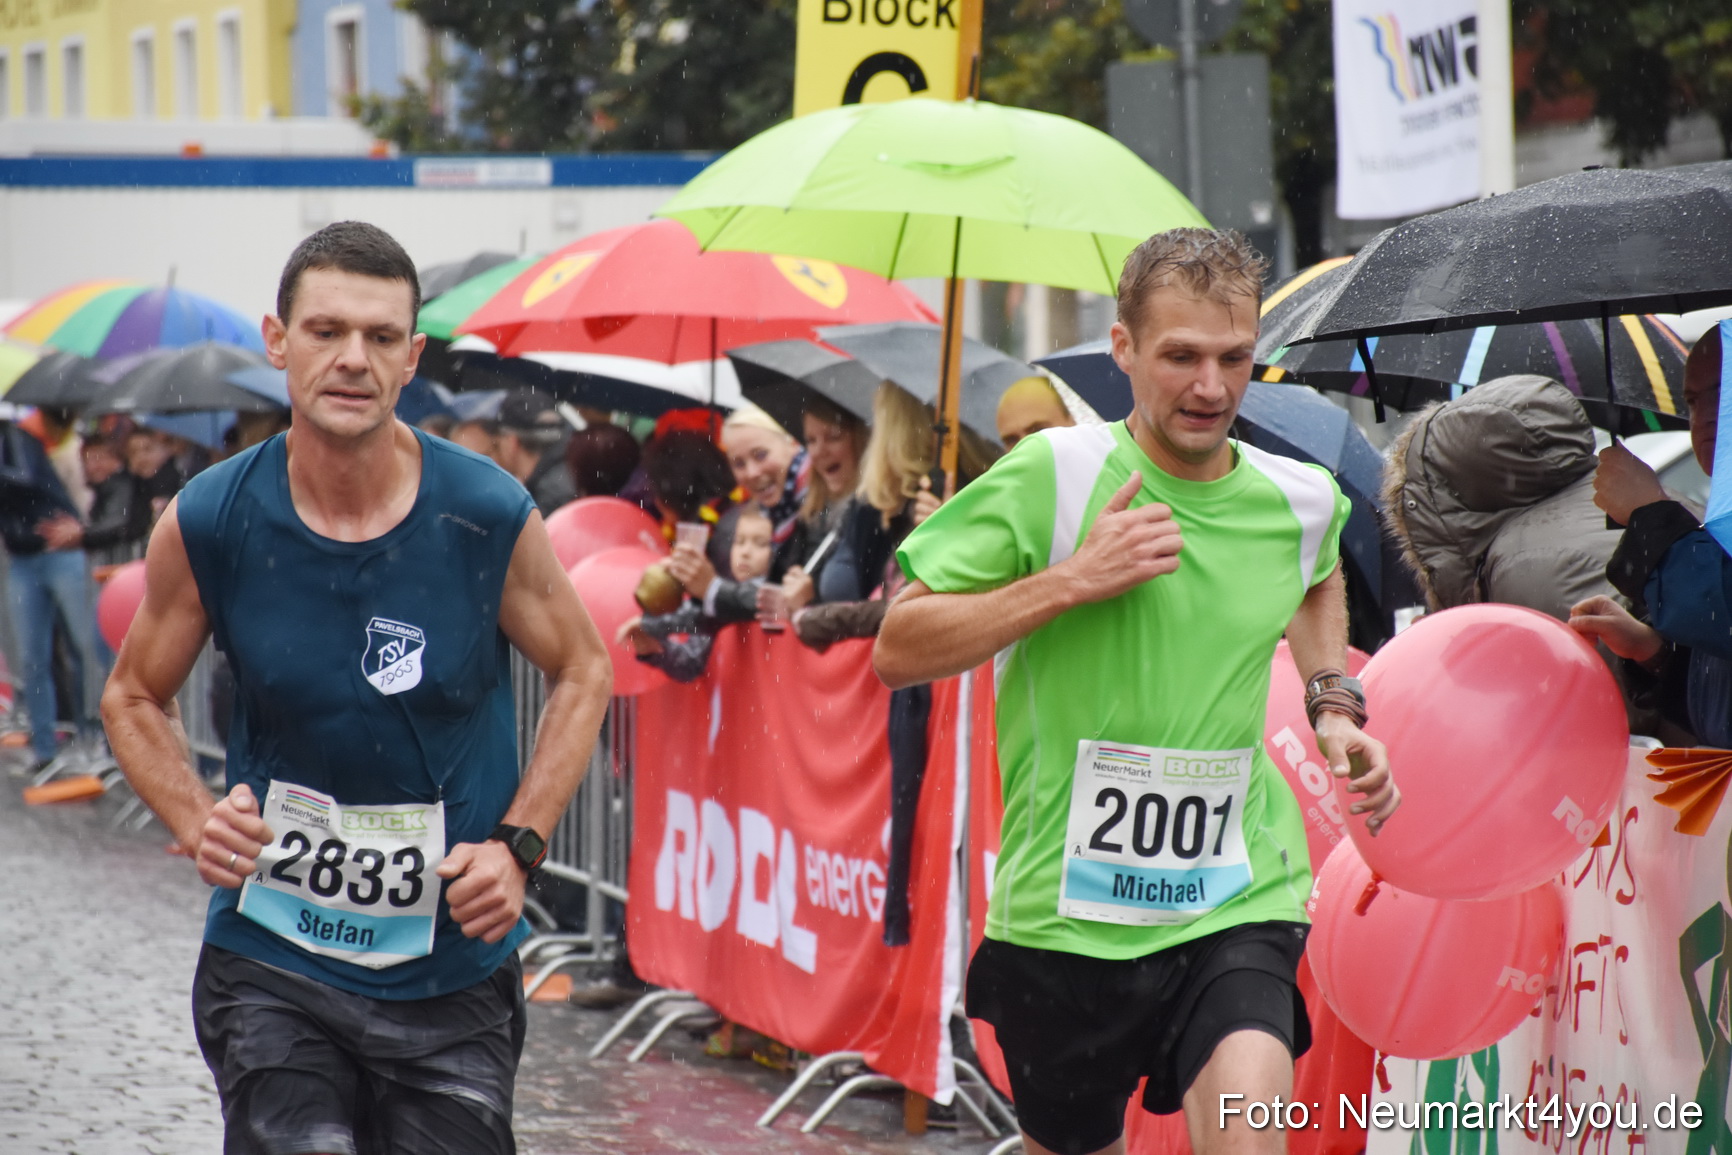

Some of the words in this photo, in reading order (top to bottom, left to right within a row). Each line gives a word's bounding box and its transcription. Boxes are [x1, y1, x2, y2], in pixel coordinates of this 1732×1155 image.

[452, 515, 489, 536] BROOKS
[374, 621, 421, 639] PAVELSBACH
[378, 637, 406, 671] TSV
[380, 659, 413, 688] 1965
[1093, 761, 1152, 779] NeuerMarkt
[1163, 756, 1241, 778] BOCK
[281, 803, 330, 827] NeuerMarkt
[341, 809, 427, 832] BOCK
[1089, 787, 1232, 860] 2001
[1073, 845, 1082, 857] A
[254, 871, 264, 884] A
[270, 830, 426, 908] 2833
[1112, 873, 1206, 904] Michael
[297, 909, 375, 947] Stefan
